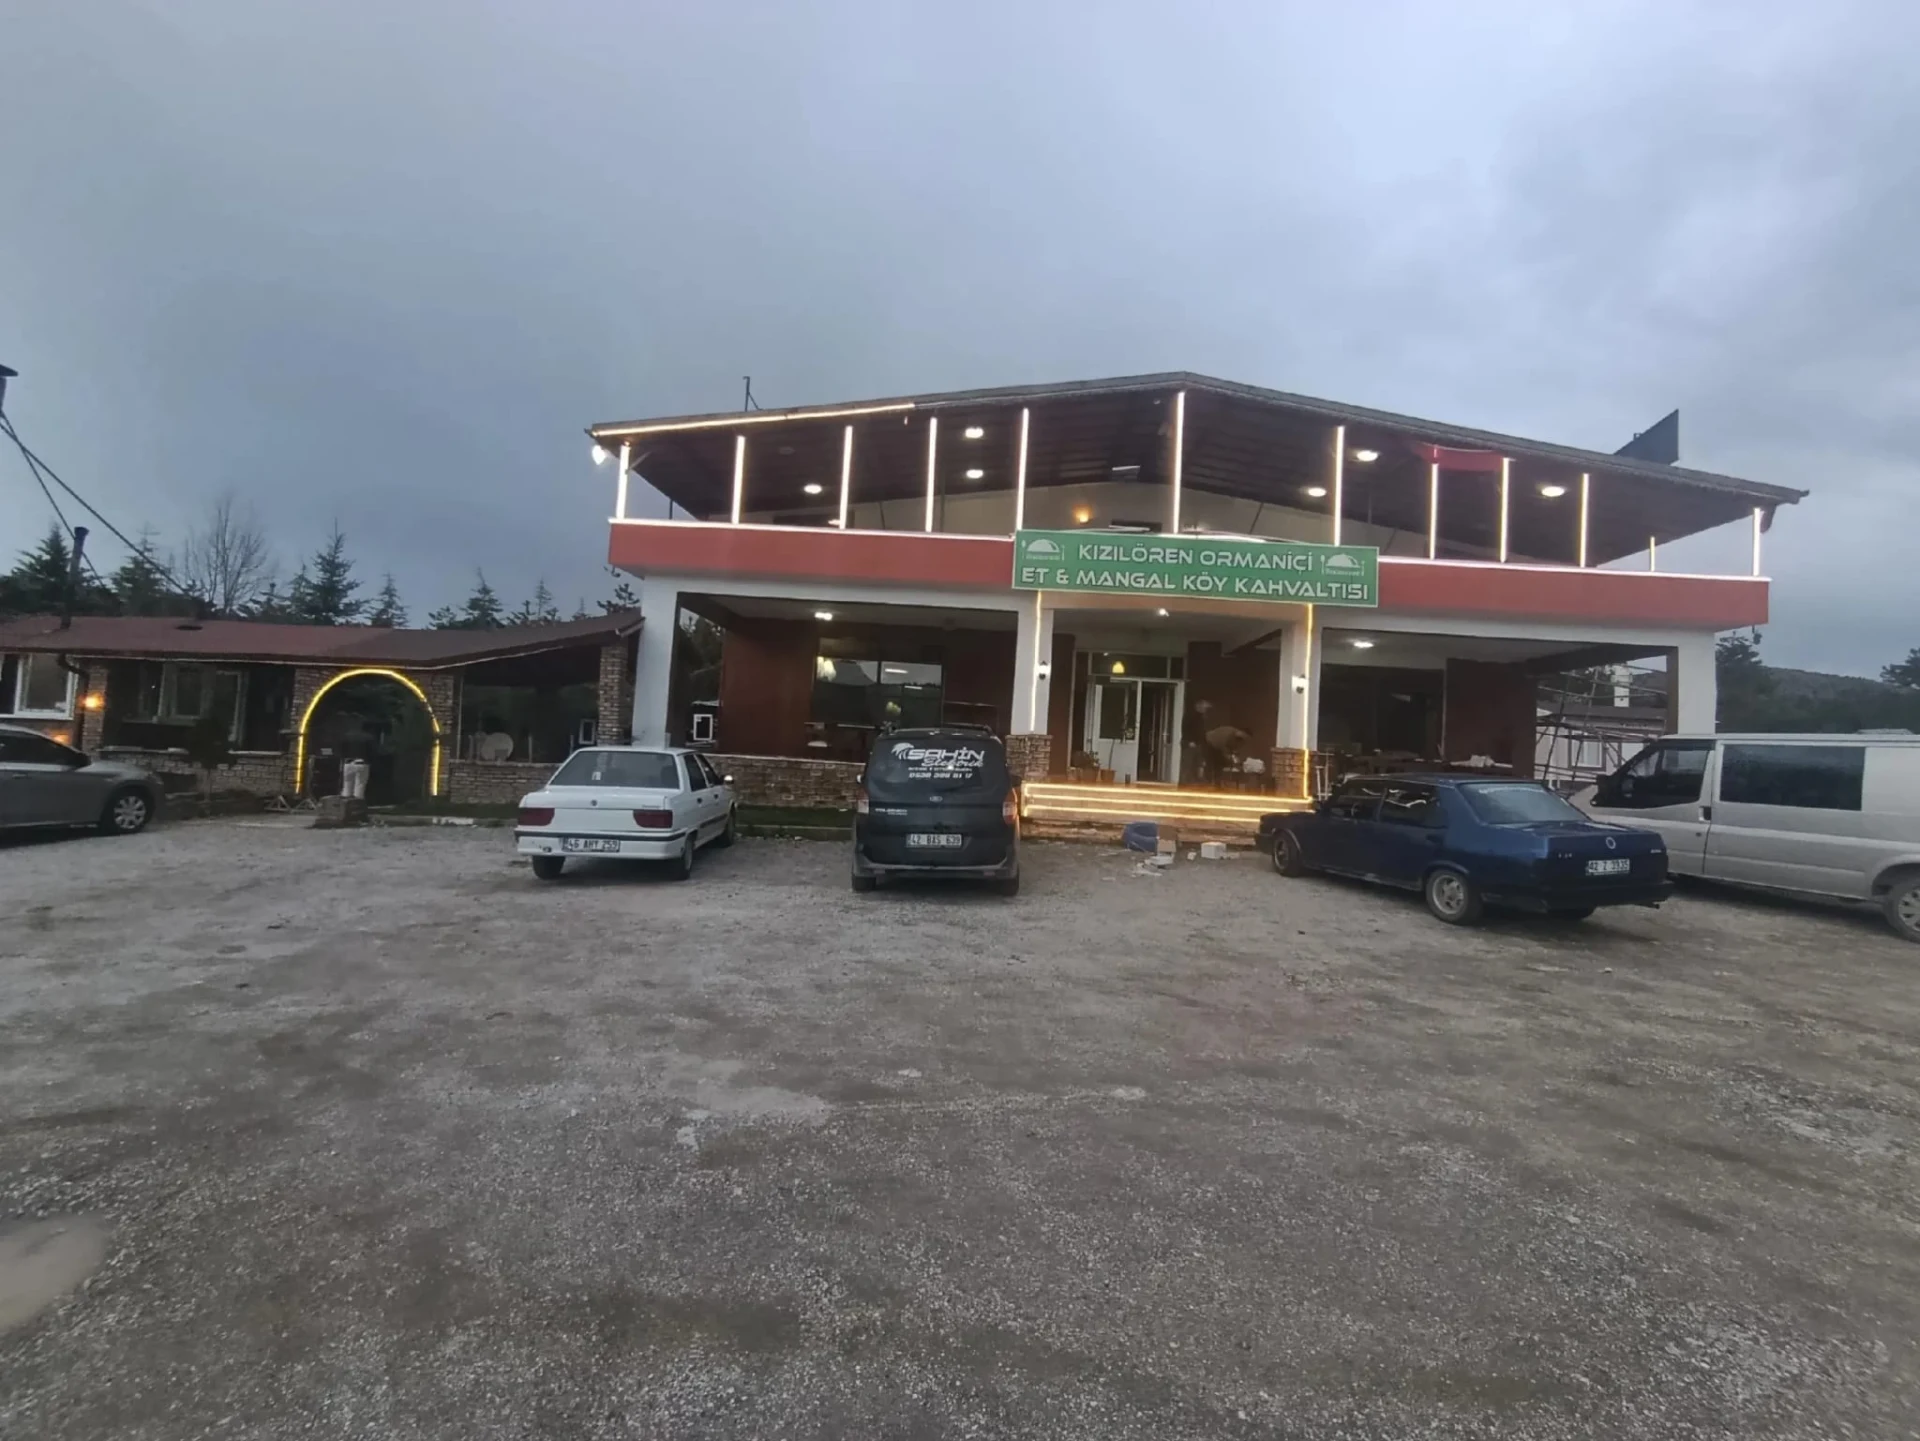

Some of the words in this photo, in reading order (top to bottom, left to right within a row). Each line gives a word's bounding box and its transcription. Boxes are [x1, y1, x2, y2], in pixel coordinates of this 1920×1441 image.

[1078, 542, 1193, 564] KIZILÖREN
[1199, 551, 1313, 574] ORMANİÇİ
[1021, 567, 1050, 584] ET
[1055, 568, 1070, 585] &
[1076, 569, 1176, 590] MANGAL
[1182, 571, 1229, 592] KÖY
[1234, 577, 1369, 600] KAHVALTISI
[911, 834, 922, 845] 42
